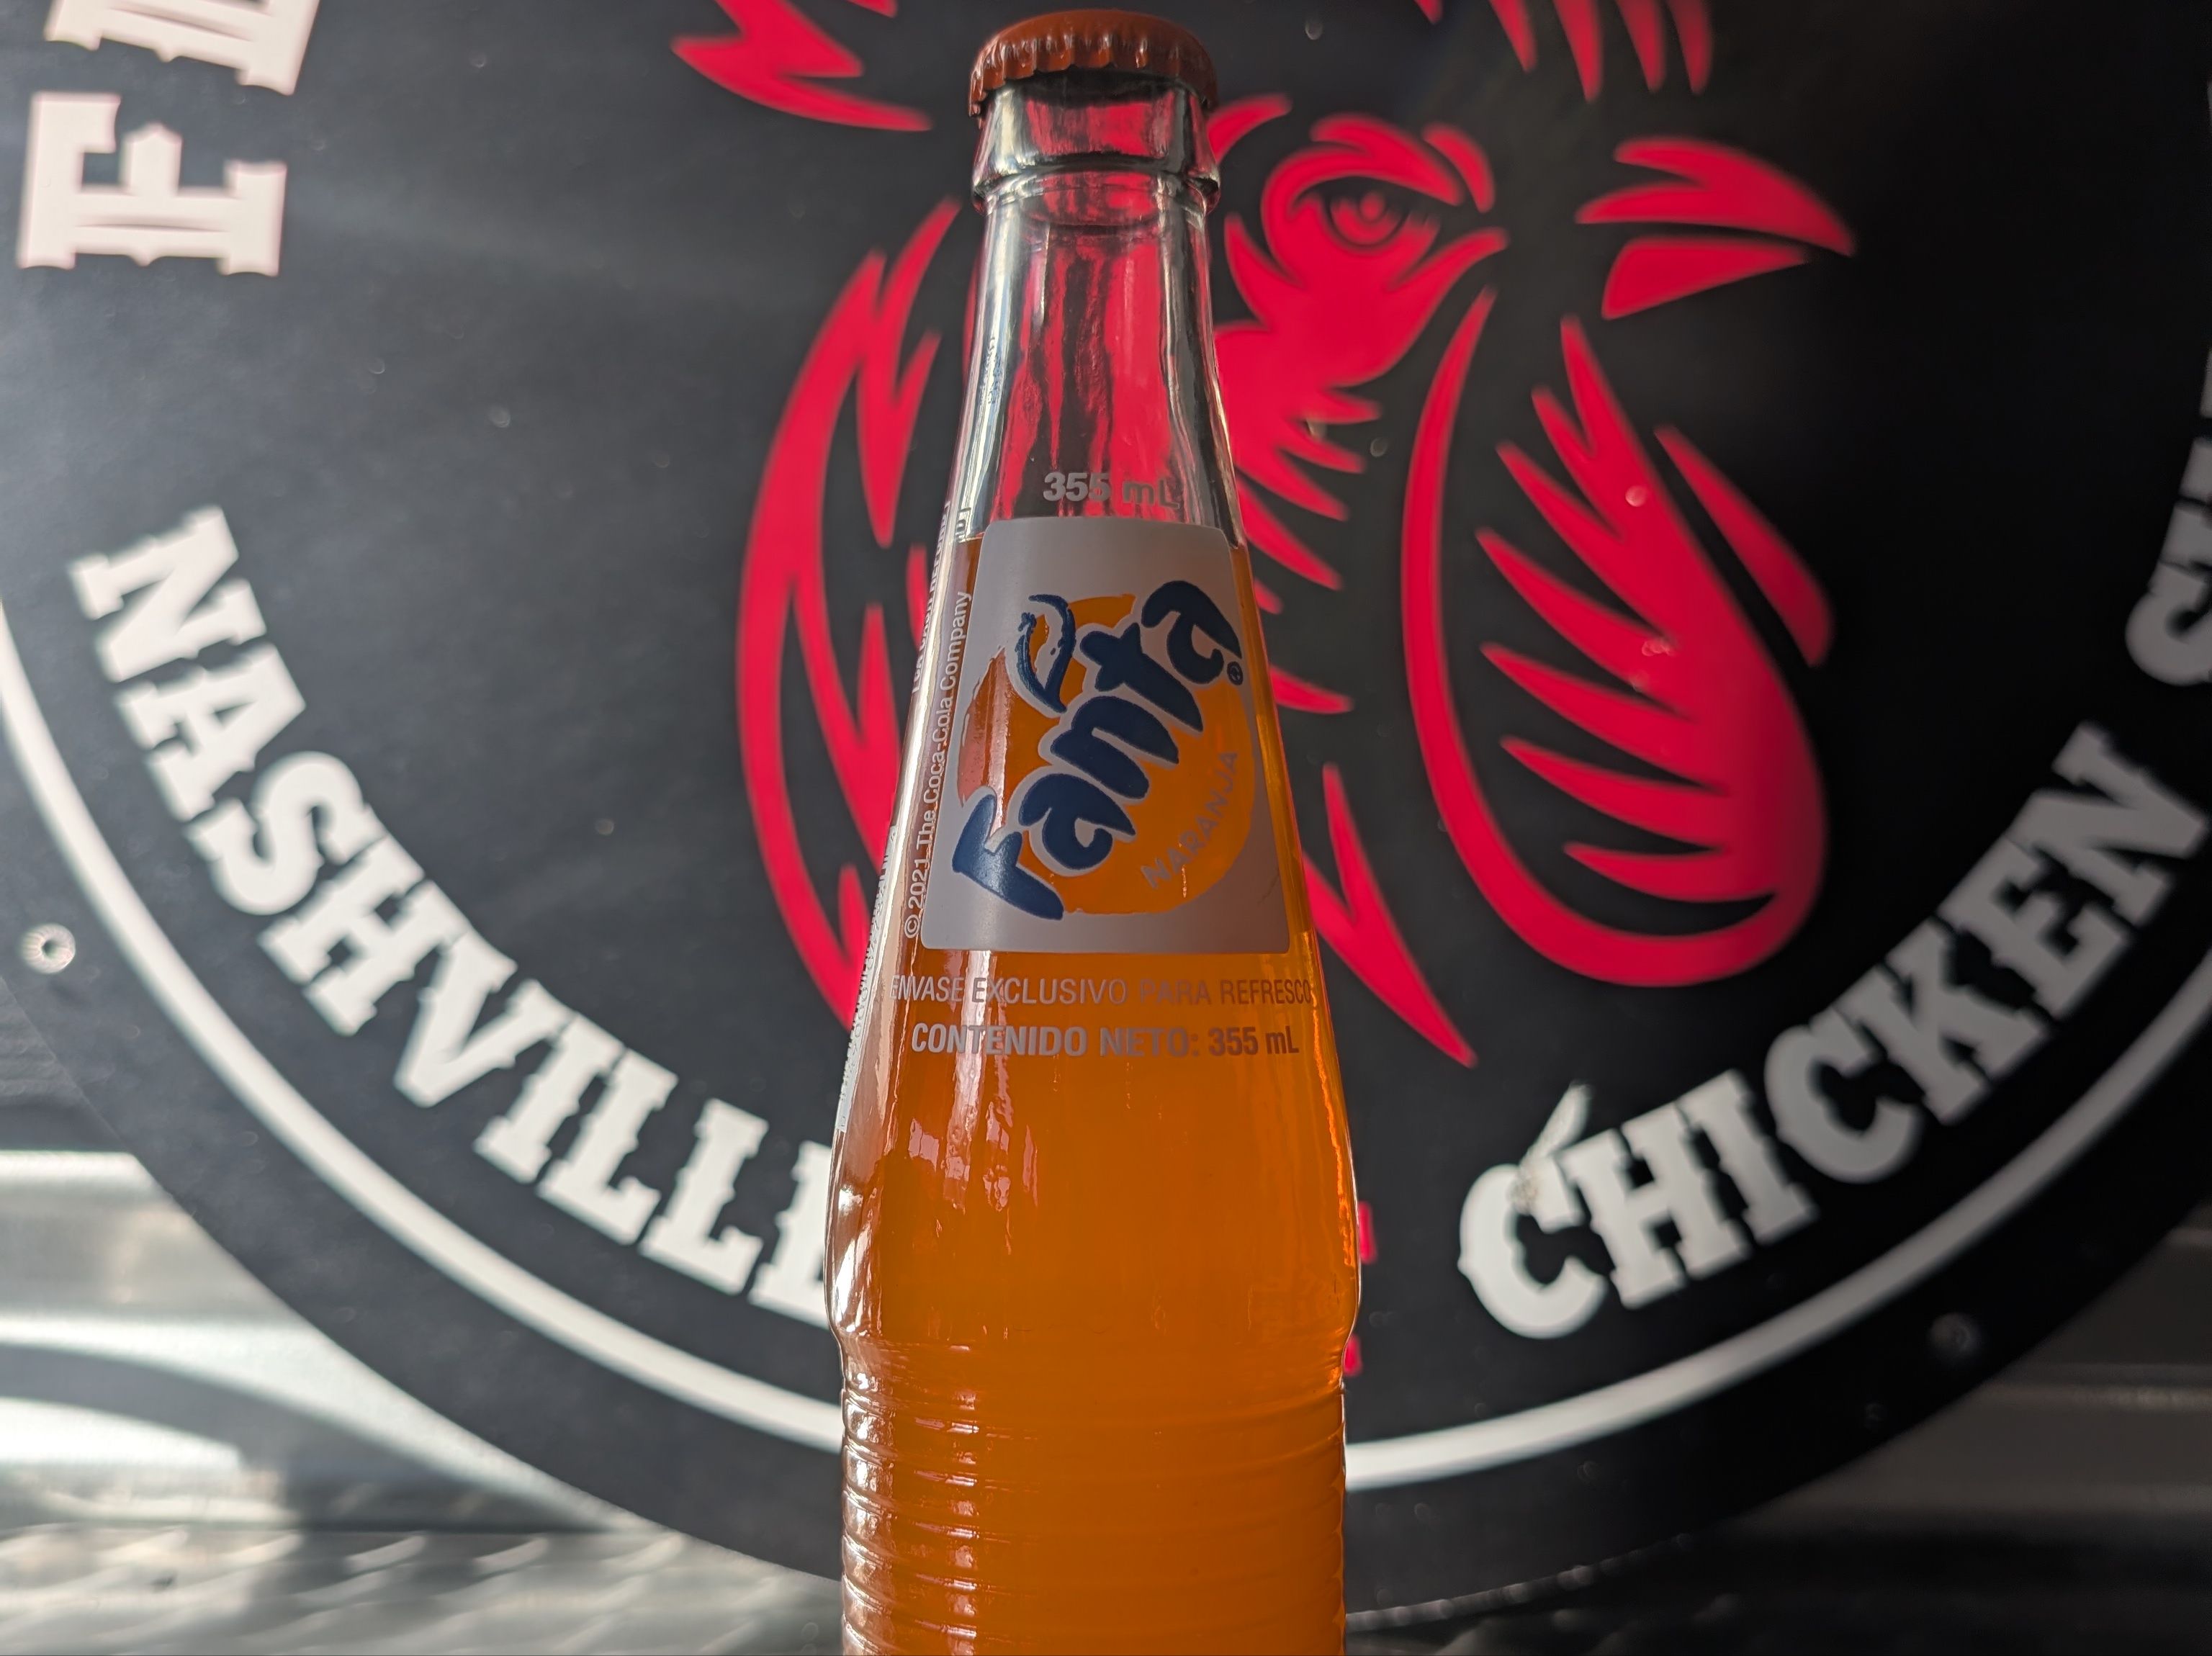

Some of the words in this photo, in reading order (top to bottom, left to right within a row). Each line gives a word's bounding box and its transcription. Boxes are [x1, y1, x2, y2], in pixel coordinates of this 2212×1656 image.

[1043, 472, 1110, 502] 355
[1123, 476, 1179, 509] mL
[940, 590, 972, 690] Company
[923, 697, 956, 806] Coca-Cola
[916, 809, 938, 850] The
[1141, 751, 1238, 889] NARANJA
[908, 858, 930, 910] 2021
[889, 974, 963, 1002] ENVASE
[971, 977, 1127, 1005] EXCLUSIVO
[1139, 978, 1211, 1005] PARA
[1220, 978, 1311, 1005] REFRESCO
[911, 1022, 1088, 1057] CONTENIDO
[1099, 1027, 1200, 1057] NETO:
[1208, 1026, 1259, 1056] 355
[1265, 1025, 1300, 1055] mL
[1456, 721, 2209, 1341] CHICKEN
